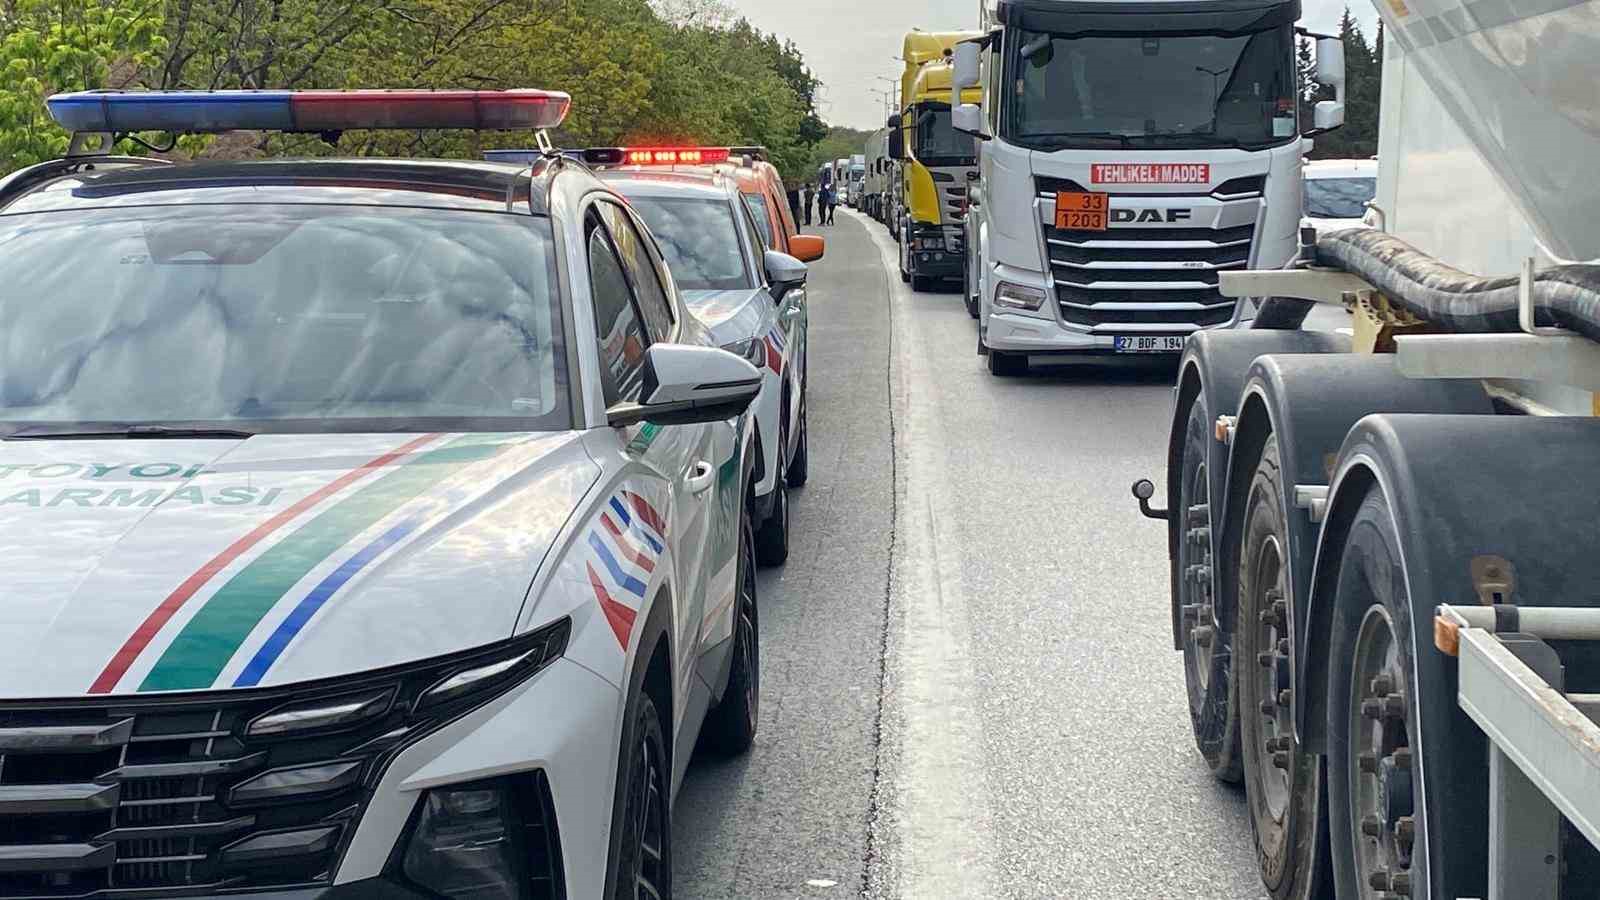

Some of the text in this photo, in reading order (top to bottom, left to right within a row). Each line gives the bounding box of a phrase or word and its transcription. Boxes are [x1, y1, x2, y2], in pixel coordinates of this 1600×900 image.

[1161, 165, 1205, 183] MADDE
[1082, 195, 1102, 208] 33
[1062, 213, 1100, 227] 1203
[1110, 208, 1191, 222] DAF
[1120, 337, 1133, 349] 27
[1164, 337, 1181, 348] 194
